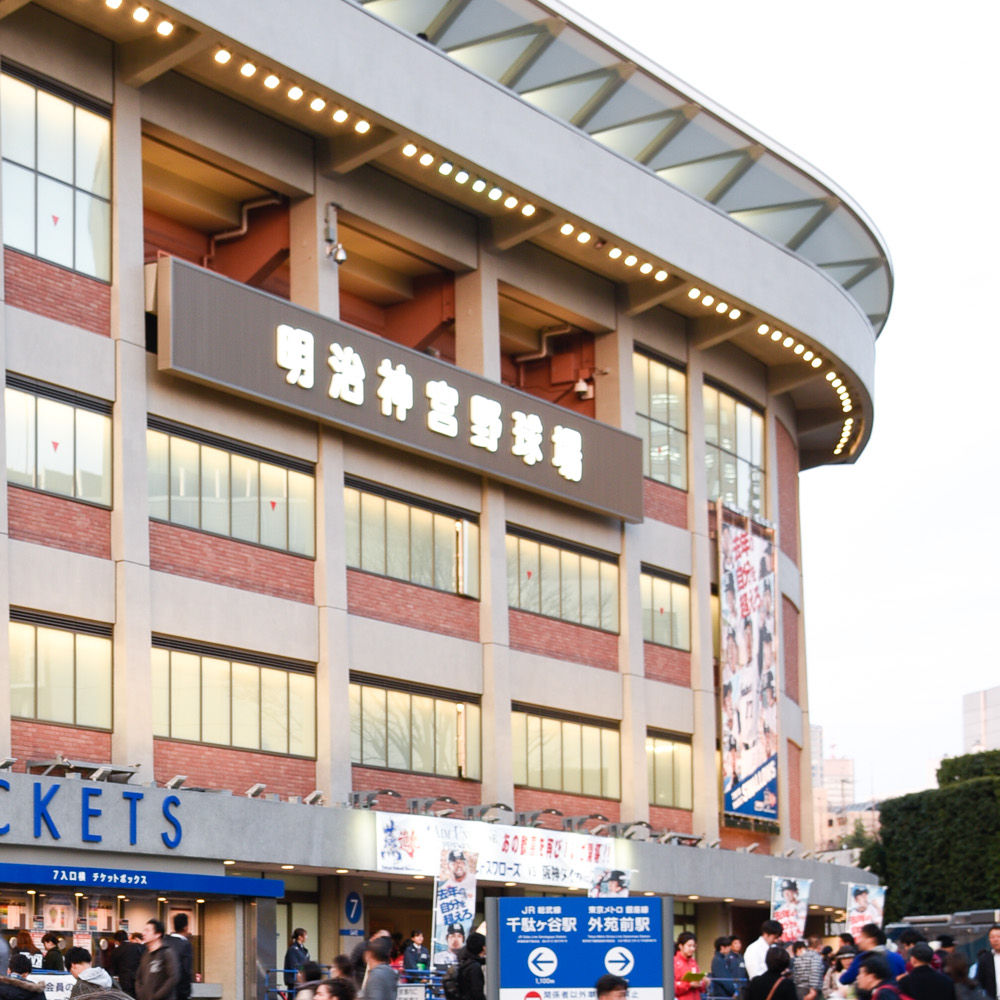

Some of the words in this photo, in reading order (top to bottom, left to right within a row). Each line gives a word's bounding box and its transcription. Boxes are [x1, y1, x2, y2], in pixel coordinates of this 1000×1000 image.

[276, 324, 582, 482] 明治神宮野球場
[92, 872, 148, 885] チケットボックス
[437, 886, 468, 900] 去年の
[350, 899, 358, 919] 7
[440, 899, 467, 914] 自分を
[521, 906, 536, 915] JR
[588, 905, 623, 915] 東京メトロ
[443, 908, 473, 926] 超えろ
[587, 916, 651, 932] 外苑前駅
[506, 917, 578, 933] 千駄ヶ谷駅
